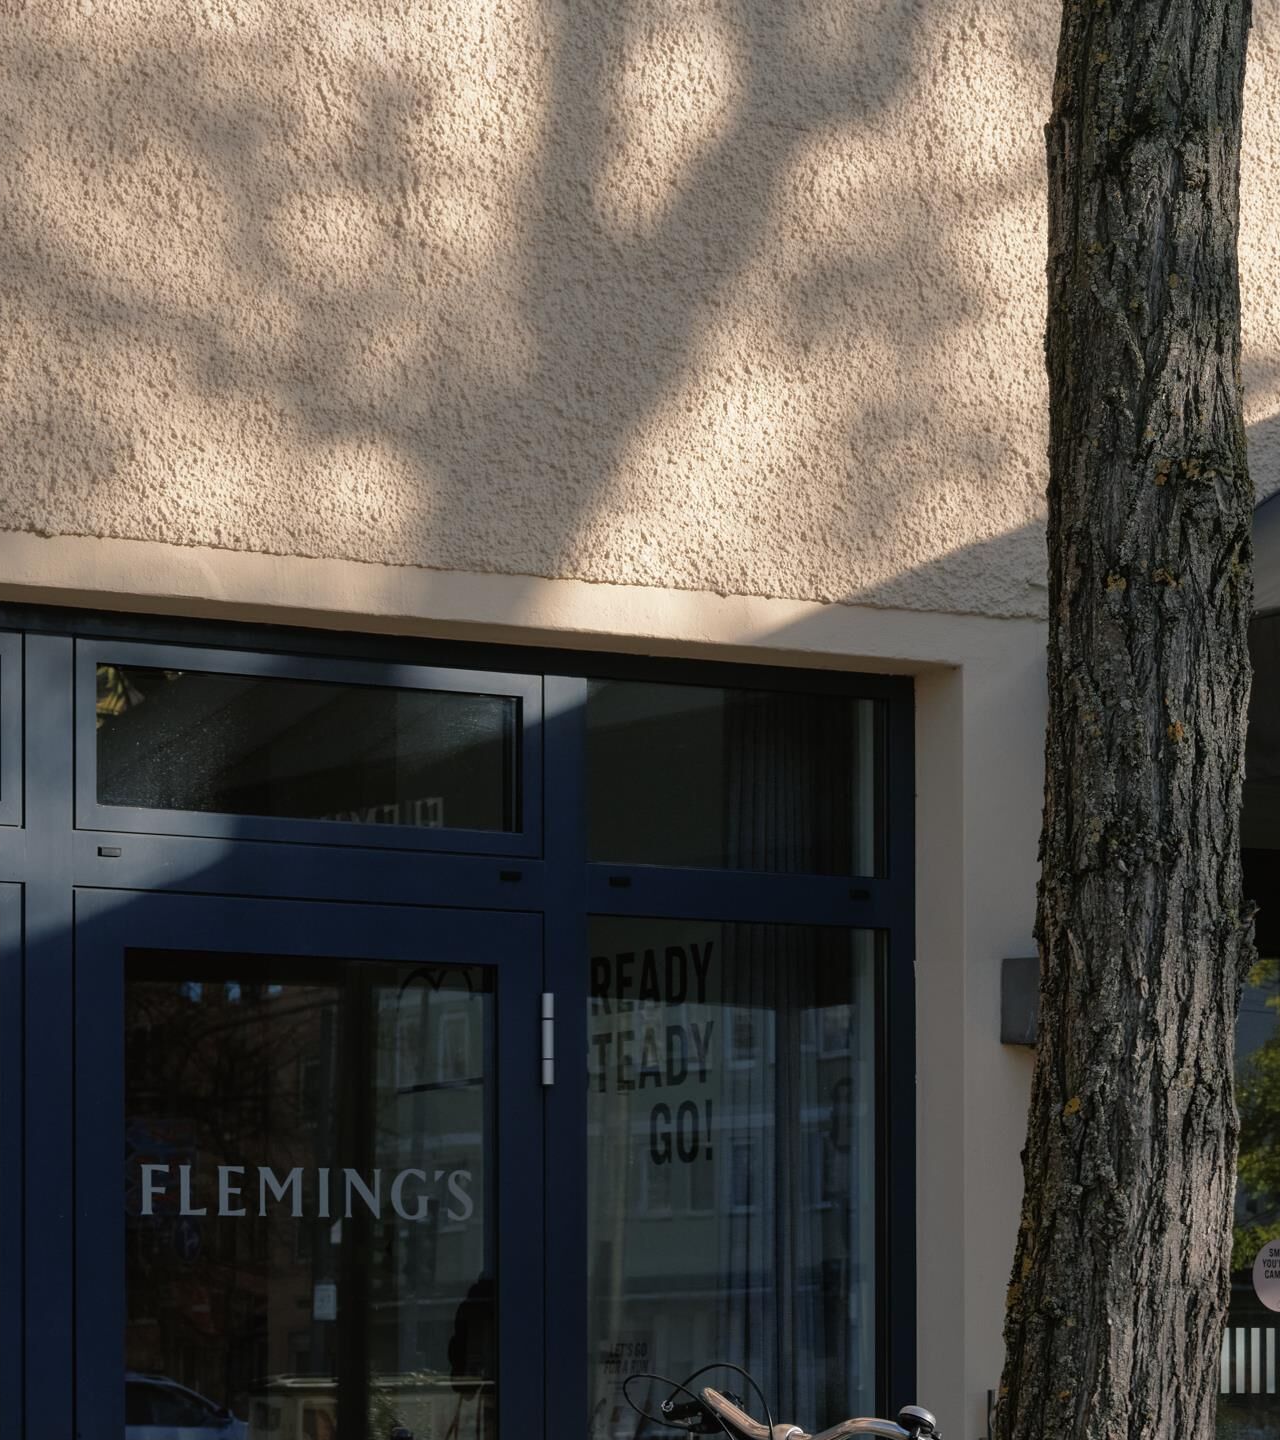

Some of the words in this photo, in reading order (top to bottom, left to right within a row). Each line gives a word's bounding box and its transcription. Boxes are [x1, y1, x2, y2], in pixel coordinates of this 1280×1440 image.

[590, 941, 714, 1017] READY
[587, 1020, 715, 1094] TEADY
[650, 1099, 713, 1166] GO!
[140, 1163, 474, 1222] FLEMING'S
